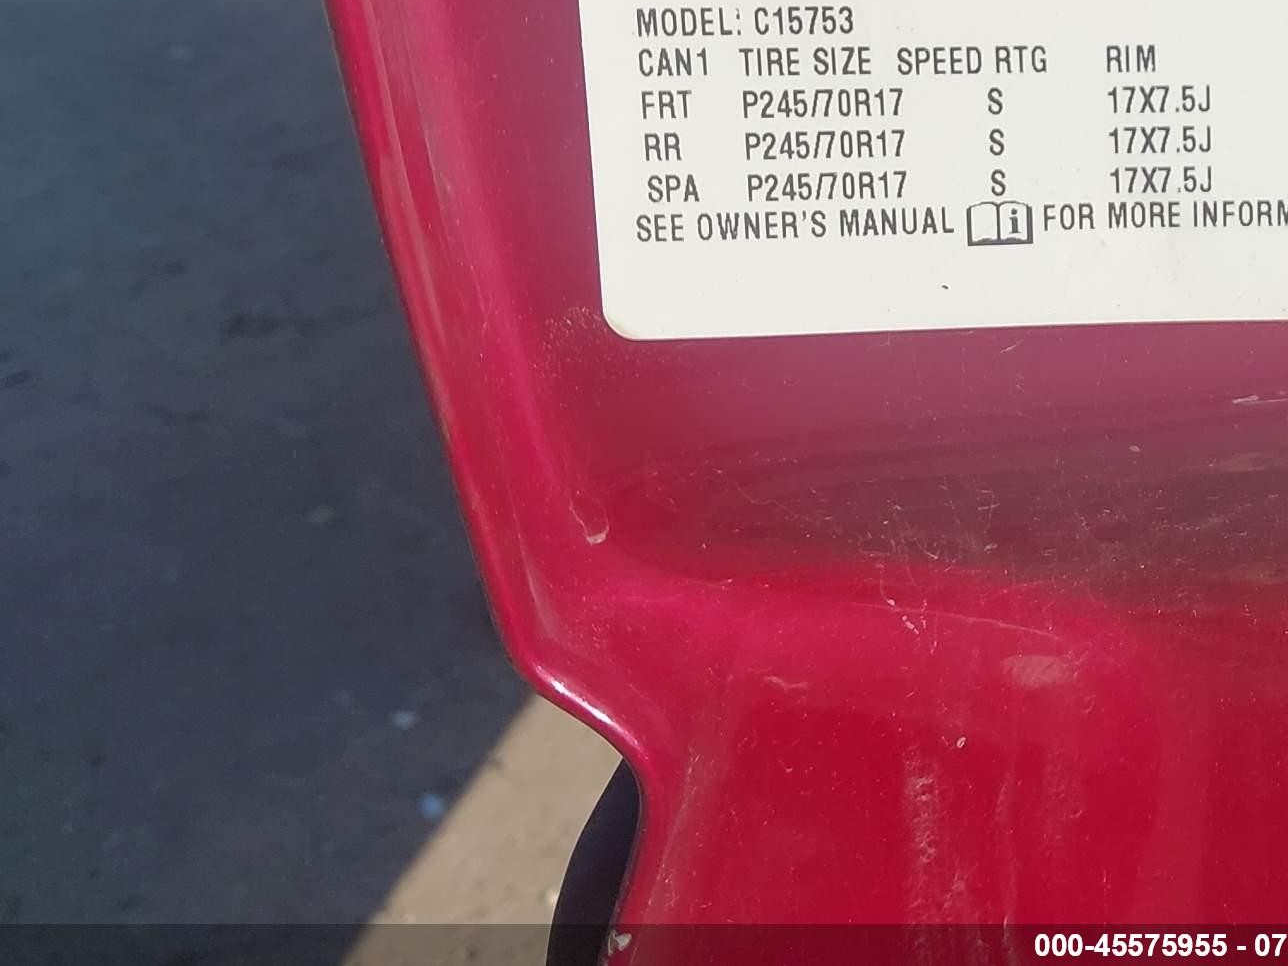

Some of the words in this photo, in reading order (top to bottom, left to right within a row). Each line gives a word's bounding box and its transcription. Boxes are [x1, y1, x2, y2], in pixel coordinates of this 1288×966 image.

[637, 7, 741, 38] MODEL:
[754, 6, 853, 35] C15753
[639, 47, 707, 77] CAN1
[738, 47, 800, 77] TIRE
[813, 46, 871, 75] SIZE
[897, 46, 982, 75] SPEED
[995, 45, 1047, 73] RTG
[1106, 45, 1156, 73] RIM
[641, 90, 692, 120] FRT
[743, 88, 903, 119] P245/70R17
[988, 87, 1003, 115] S
[1108, 85, 1210, 114] 17X7.5J
[644, 132, 682, 161] RR
[745, 129, 905, 161] P245/70R17
[989, 128, 1005, 156] S
[1109, 125, 1211, 154] 17X7.5J
[648, 174, 700, 203] SPA
[747, 170, 907, 202] P245/70R17
[991, 169, 1006, 196] S
[1110, 166, 1211, 194] 17X7.5J
[636, 214, 684, 242] SEE
[840, 206, 954, 237] MANUAL
[1043, 203, 1095, 231] FOR
[1108, 201, 1180, 229] MORE
